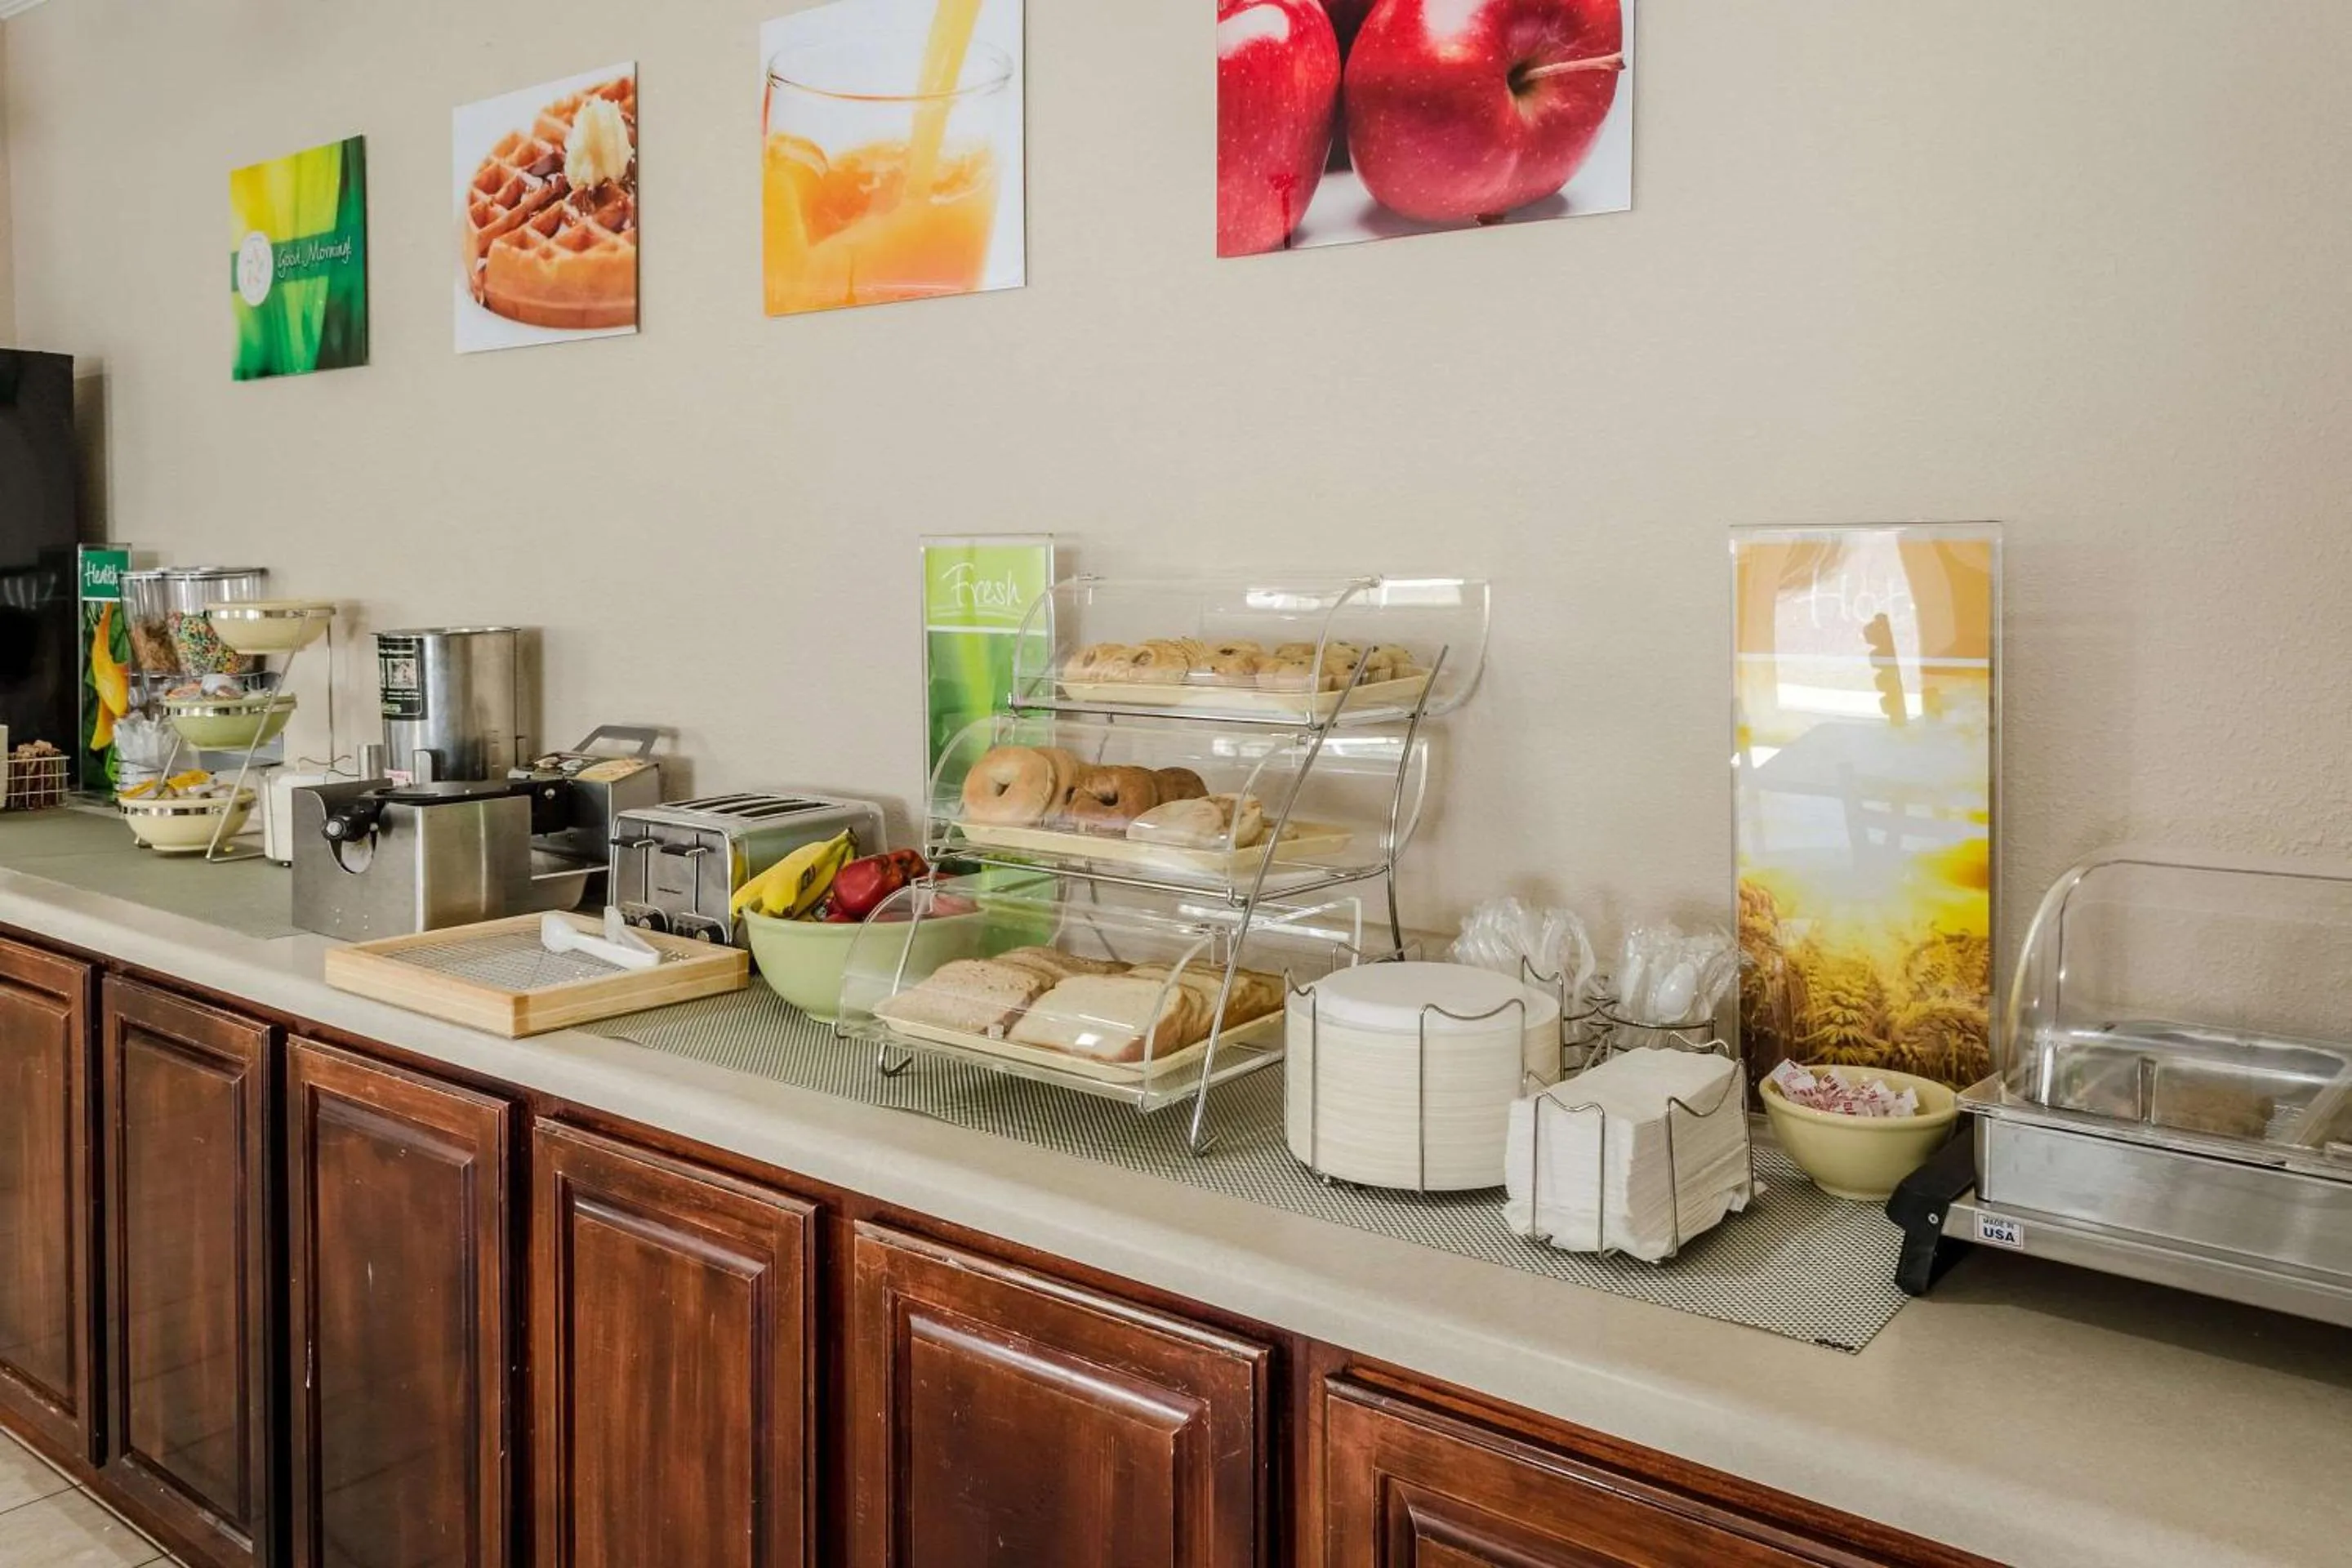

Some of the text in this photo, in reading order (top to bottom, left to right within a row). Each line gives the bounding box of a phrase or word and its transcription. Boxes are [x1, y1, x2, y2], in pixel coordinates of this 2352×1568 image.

[278, 247, 301, 278] Good
[941, 562, 1022, 608] Fresh
[1793, 560, 1909, 629] Hot
[1984, 1226, 2016, 1243] USA
